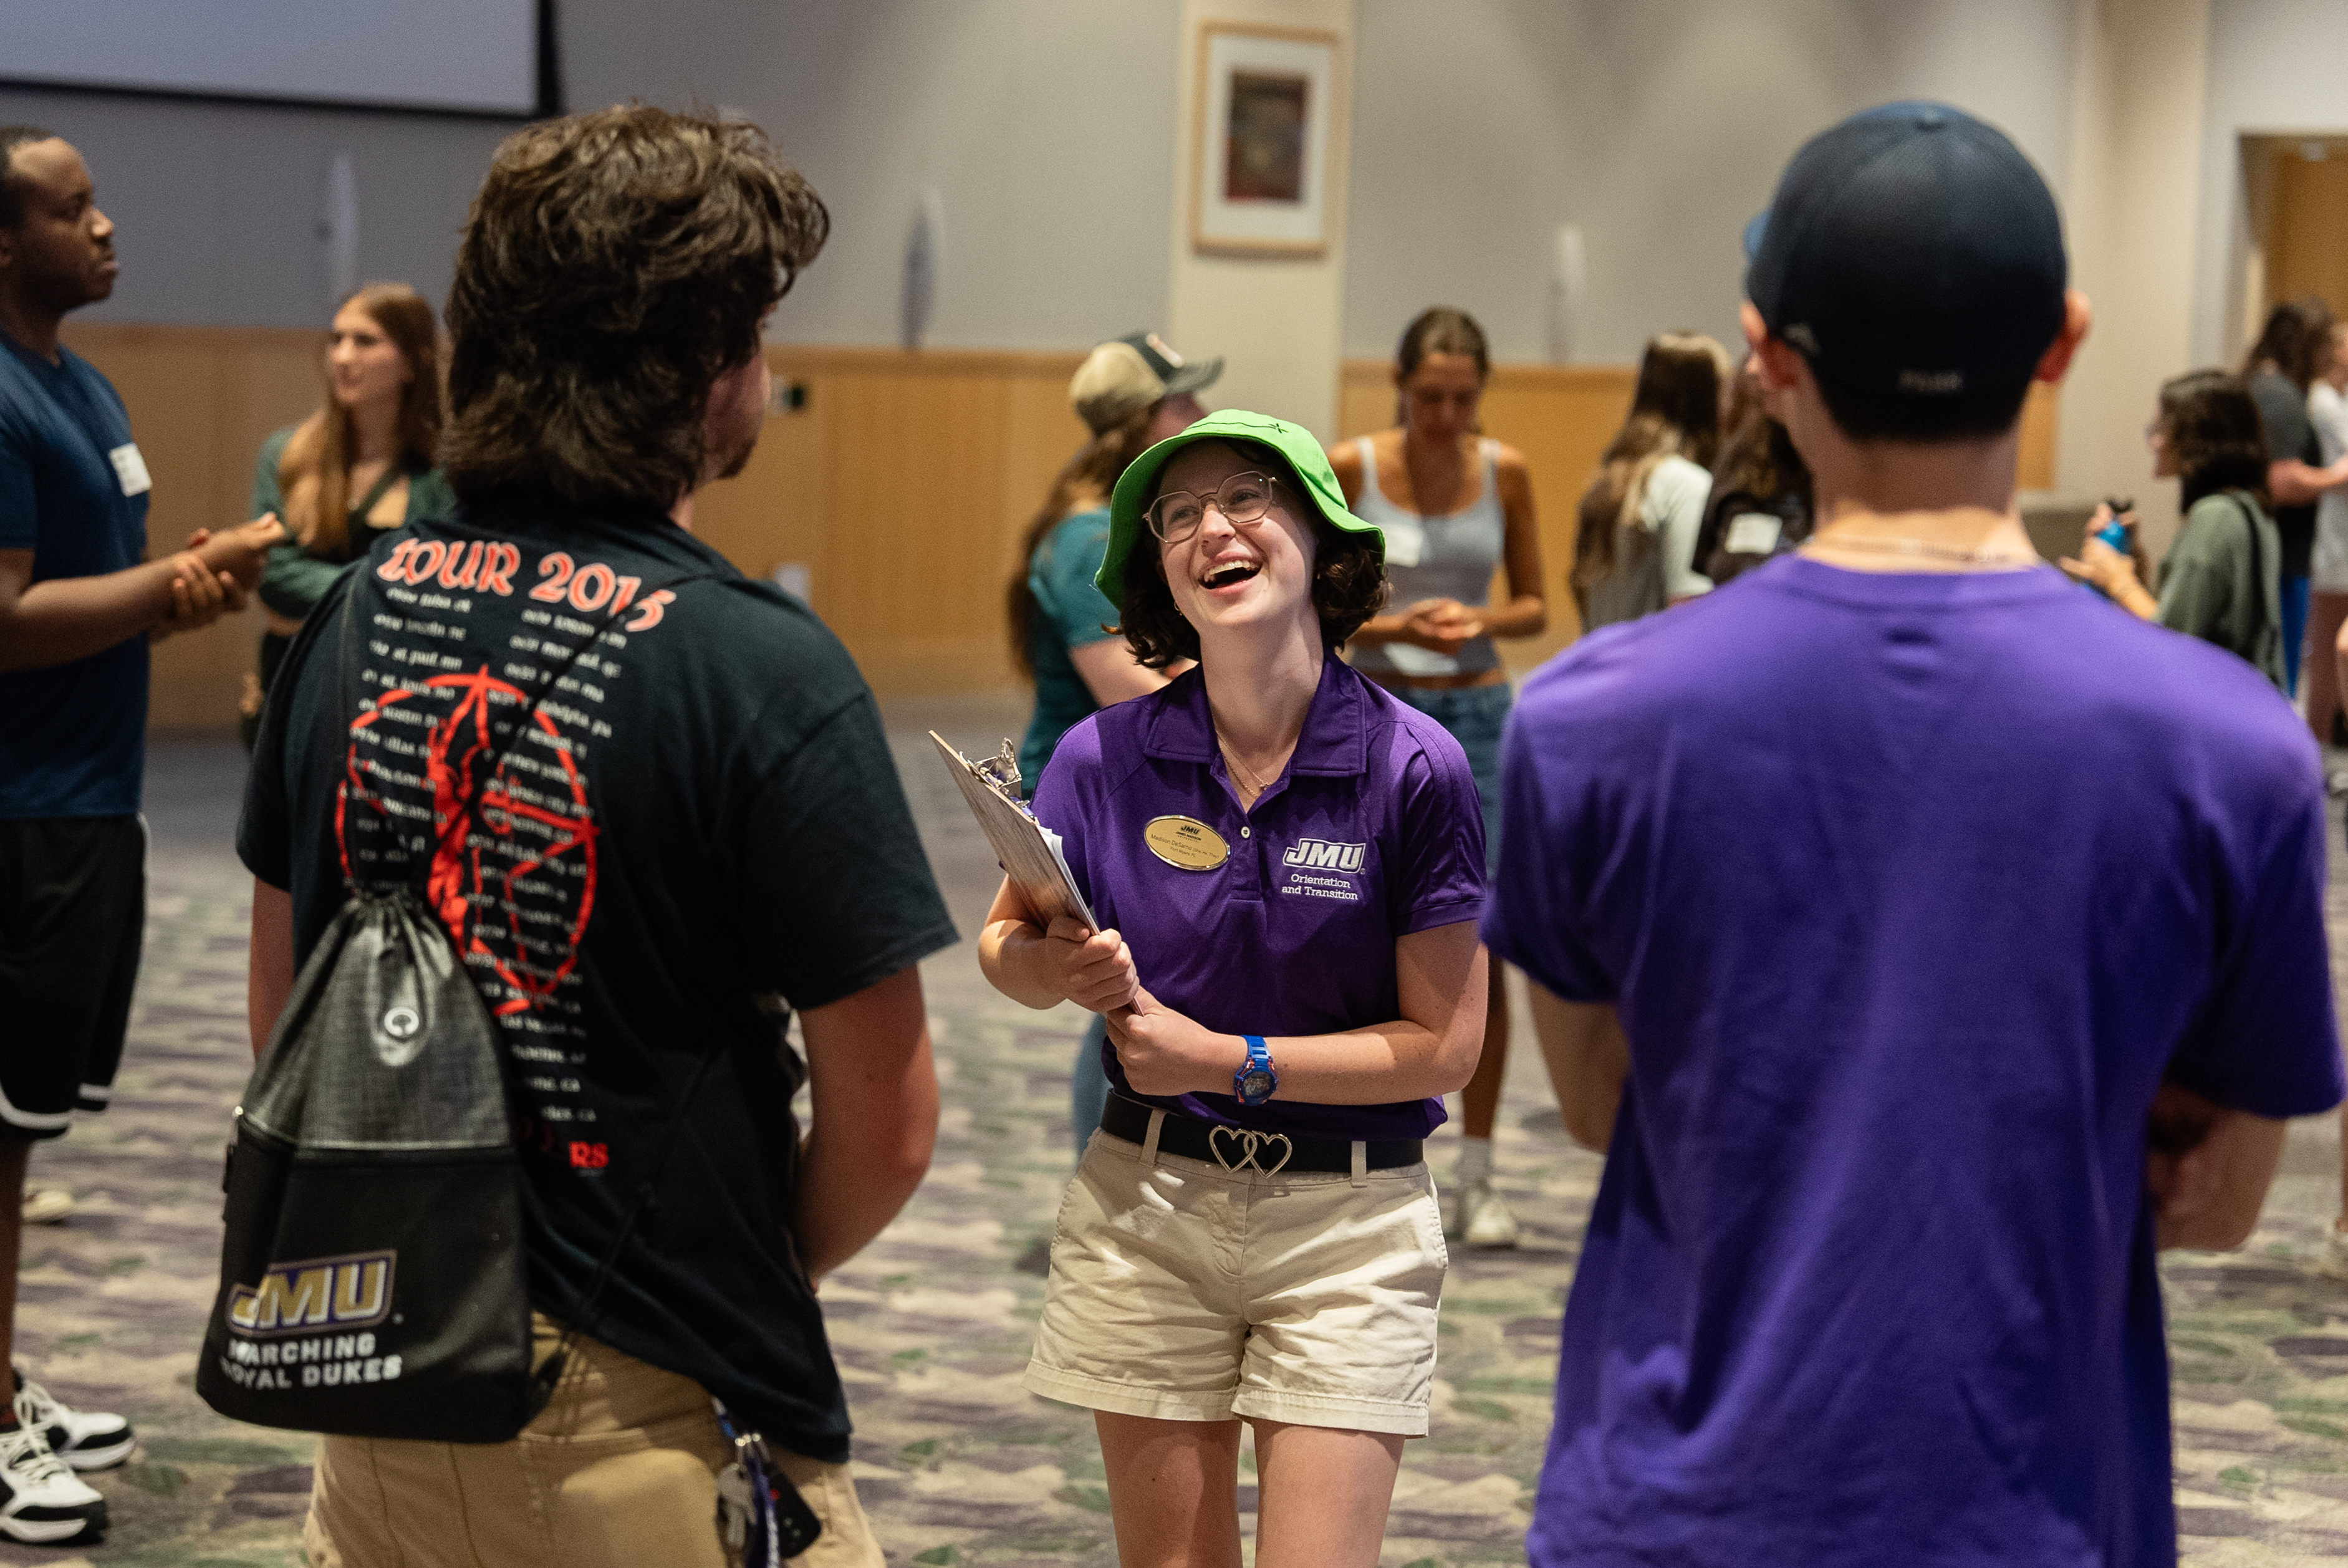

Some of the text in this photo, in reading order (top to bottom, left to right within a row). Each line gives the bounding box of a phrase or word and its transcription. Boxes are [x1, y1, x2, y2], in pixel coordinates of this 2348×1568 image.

[529, 551, 677, 632] 2015
[1180, 825, 1200, 835] JMU
[1151, 834, 1171, 844] Madison
[1286, 842, 1362, 870] JMU
[1291, 873, 1351, 888] Orientation
[1282, 885, 1359, 900] and Transition
[301, 1354, 403, 1387] DUKES
